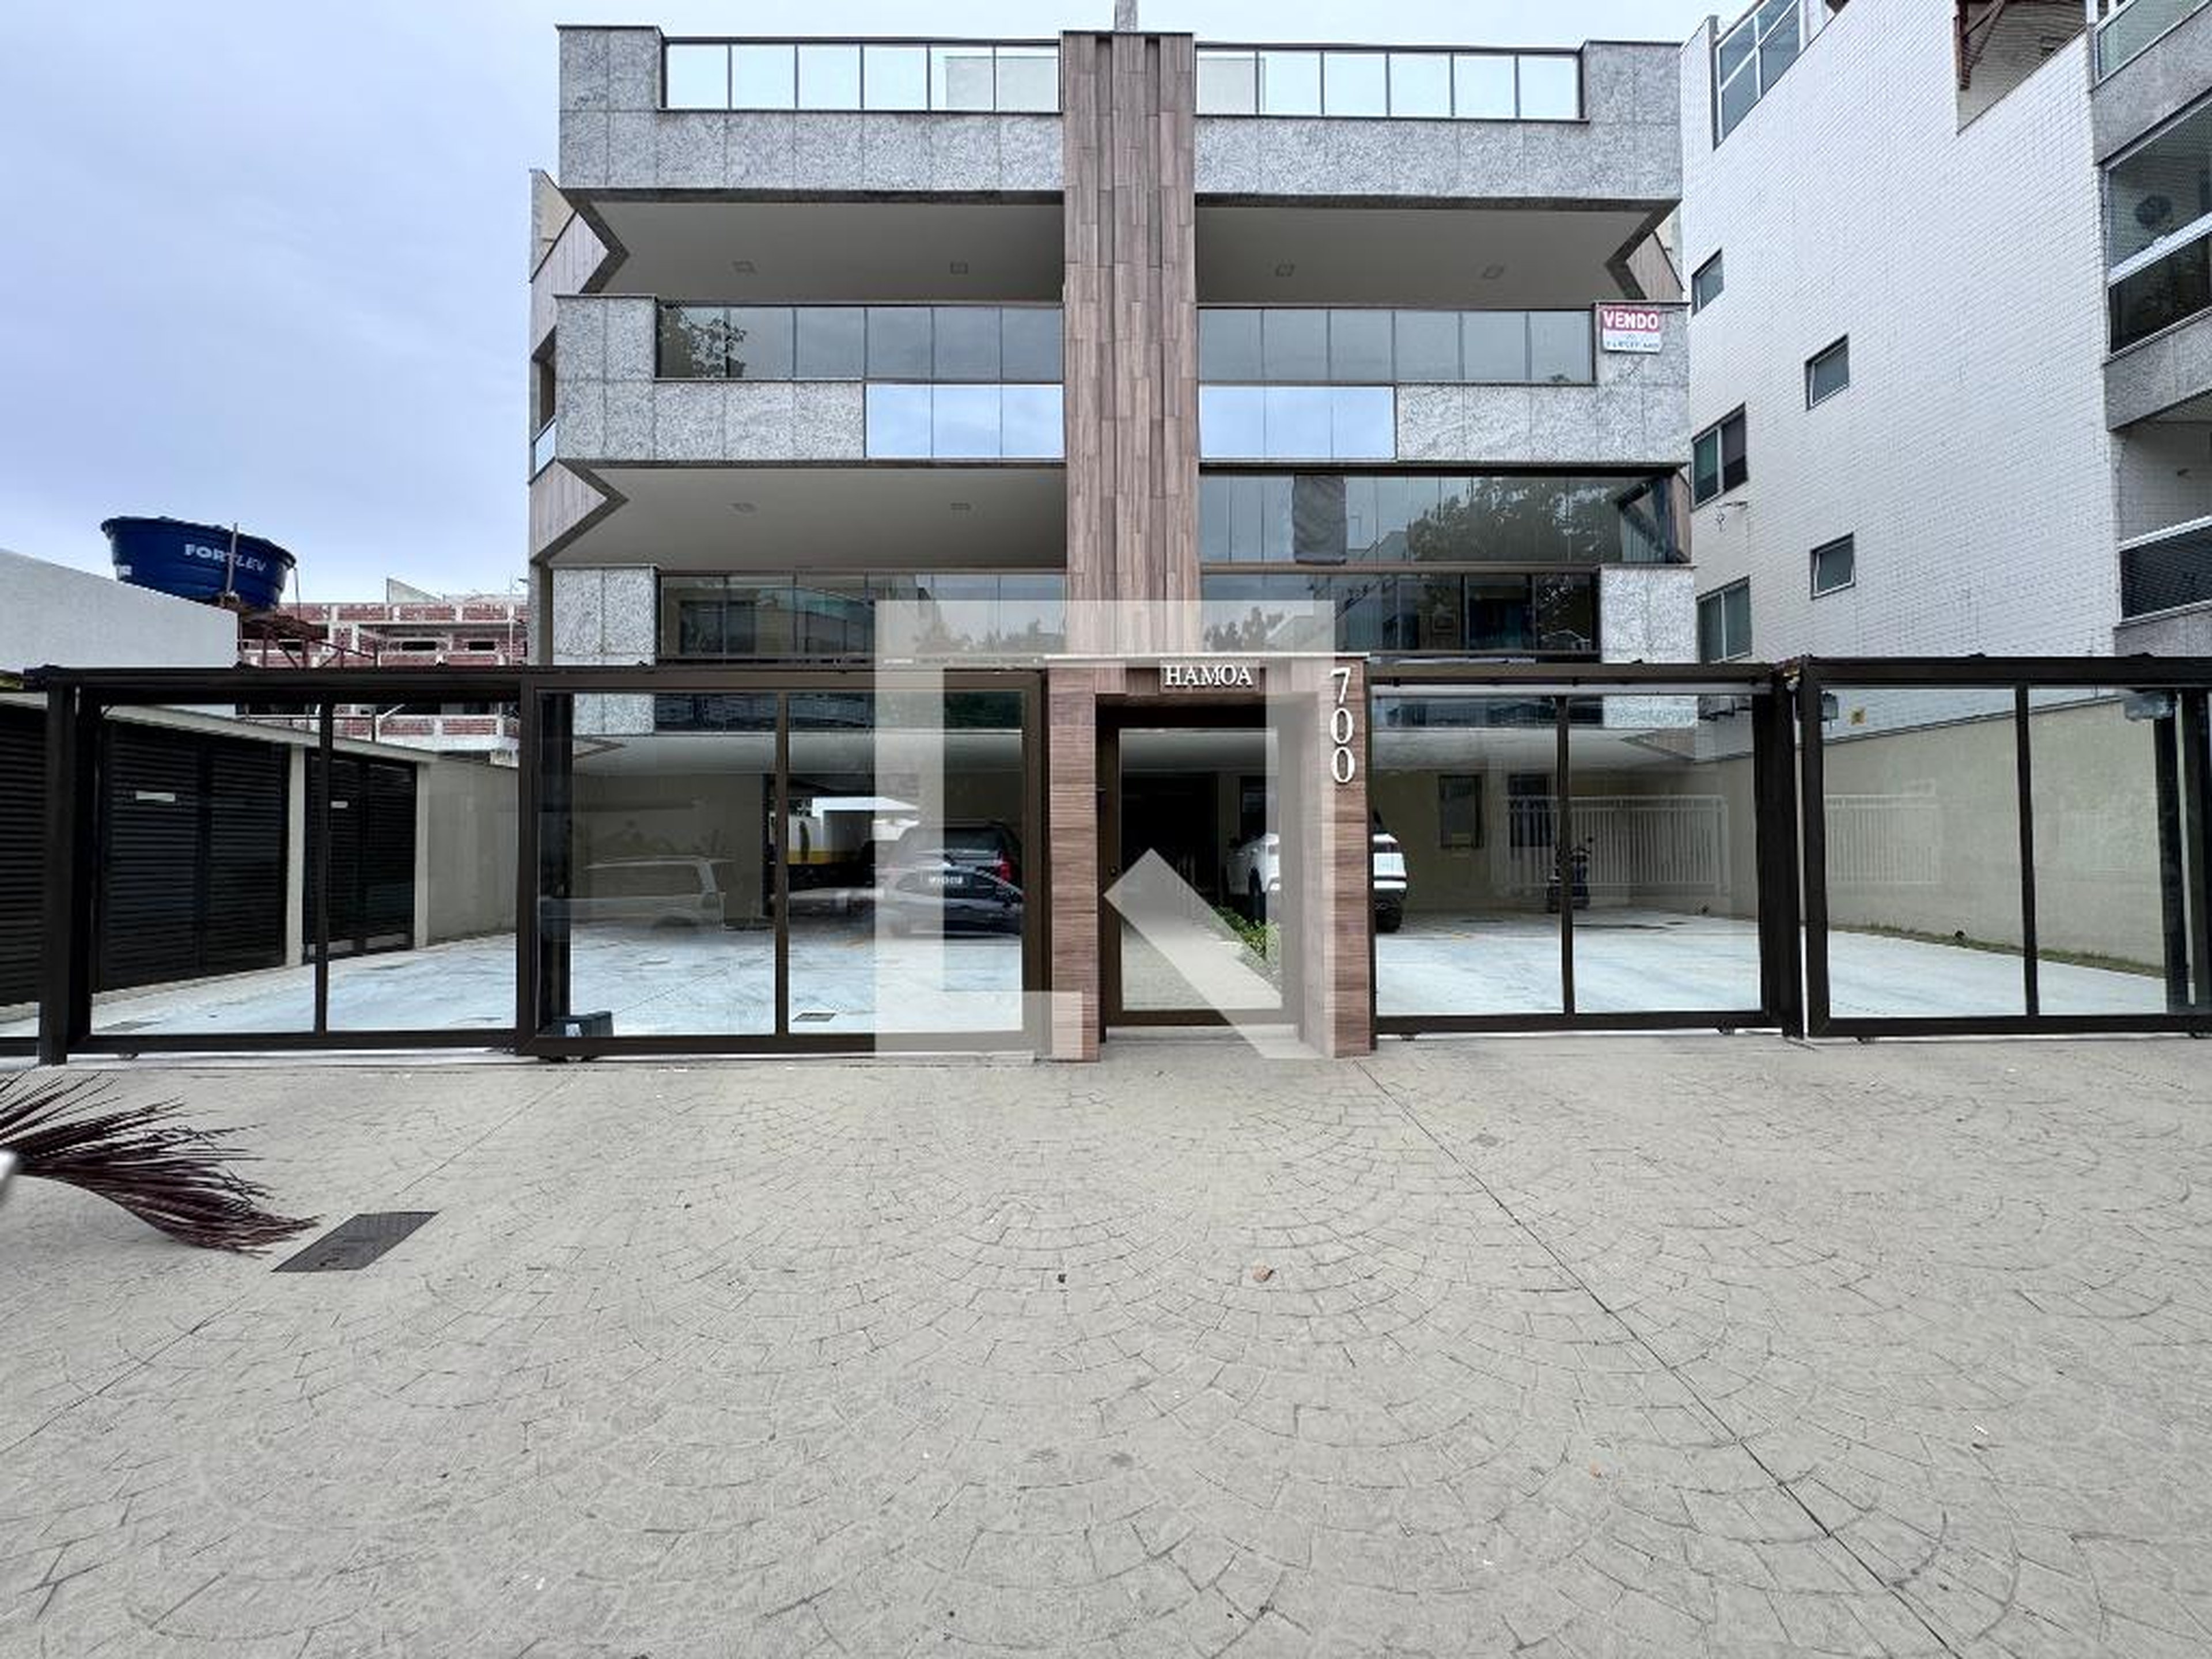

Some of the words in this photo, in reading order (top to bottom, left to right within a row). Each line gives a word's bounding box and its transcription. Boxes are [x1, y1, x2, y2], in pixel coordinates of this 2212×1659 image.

[1603, 310, 1658, 330] VENDO
[1164, 664, 1253, 686] HAMOA
[1330, 666, 1355, 783] 700
